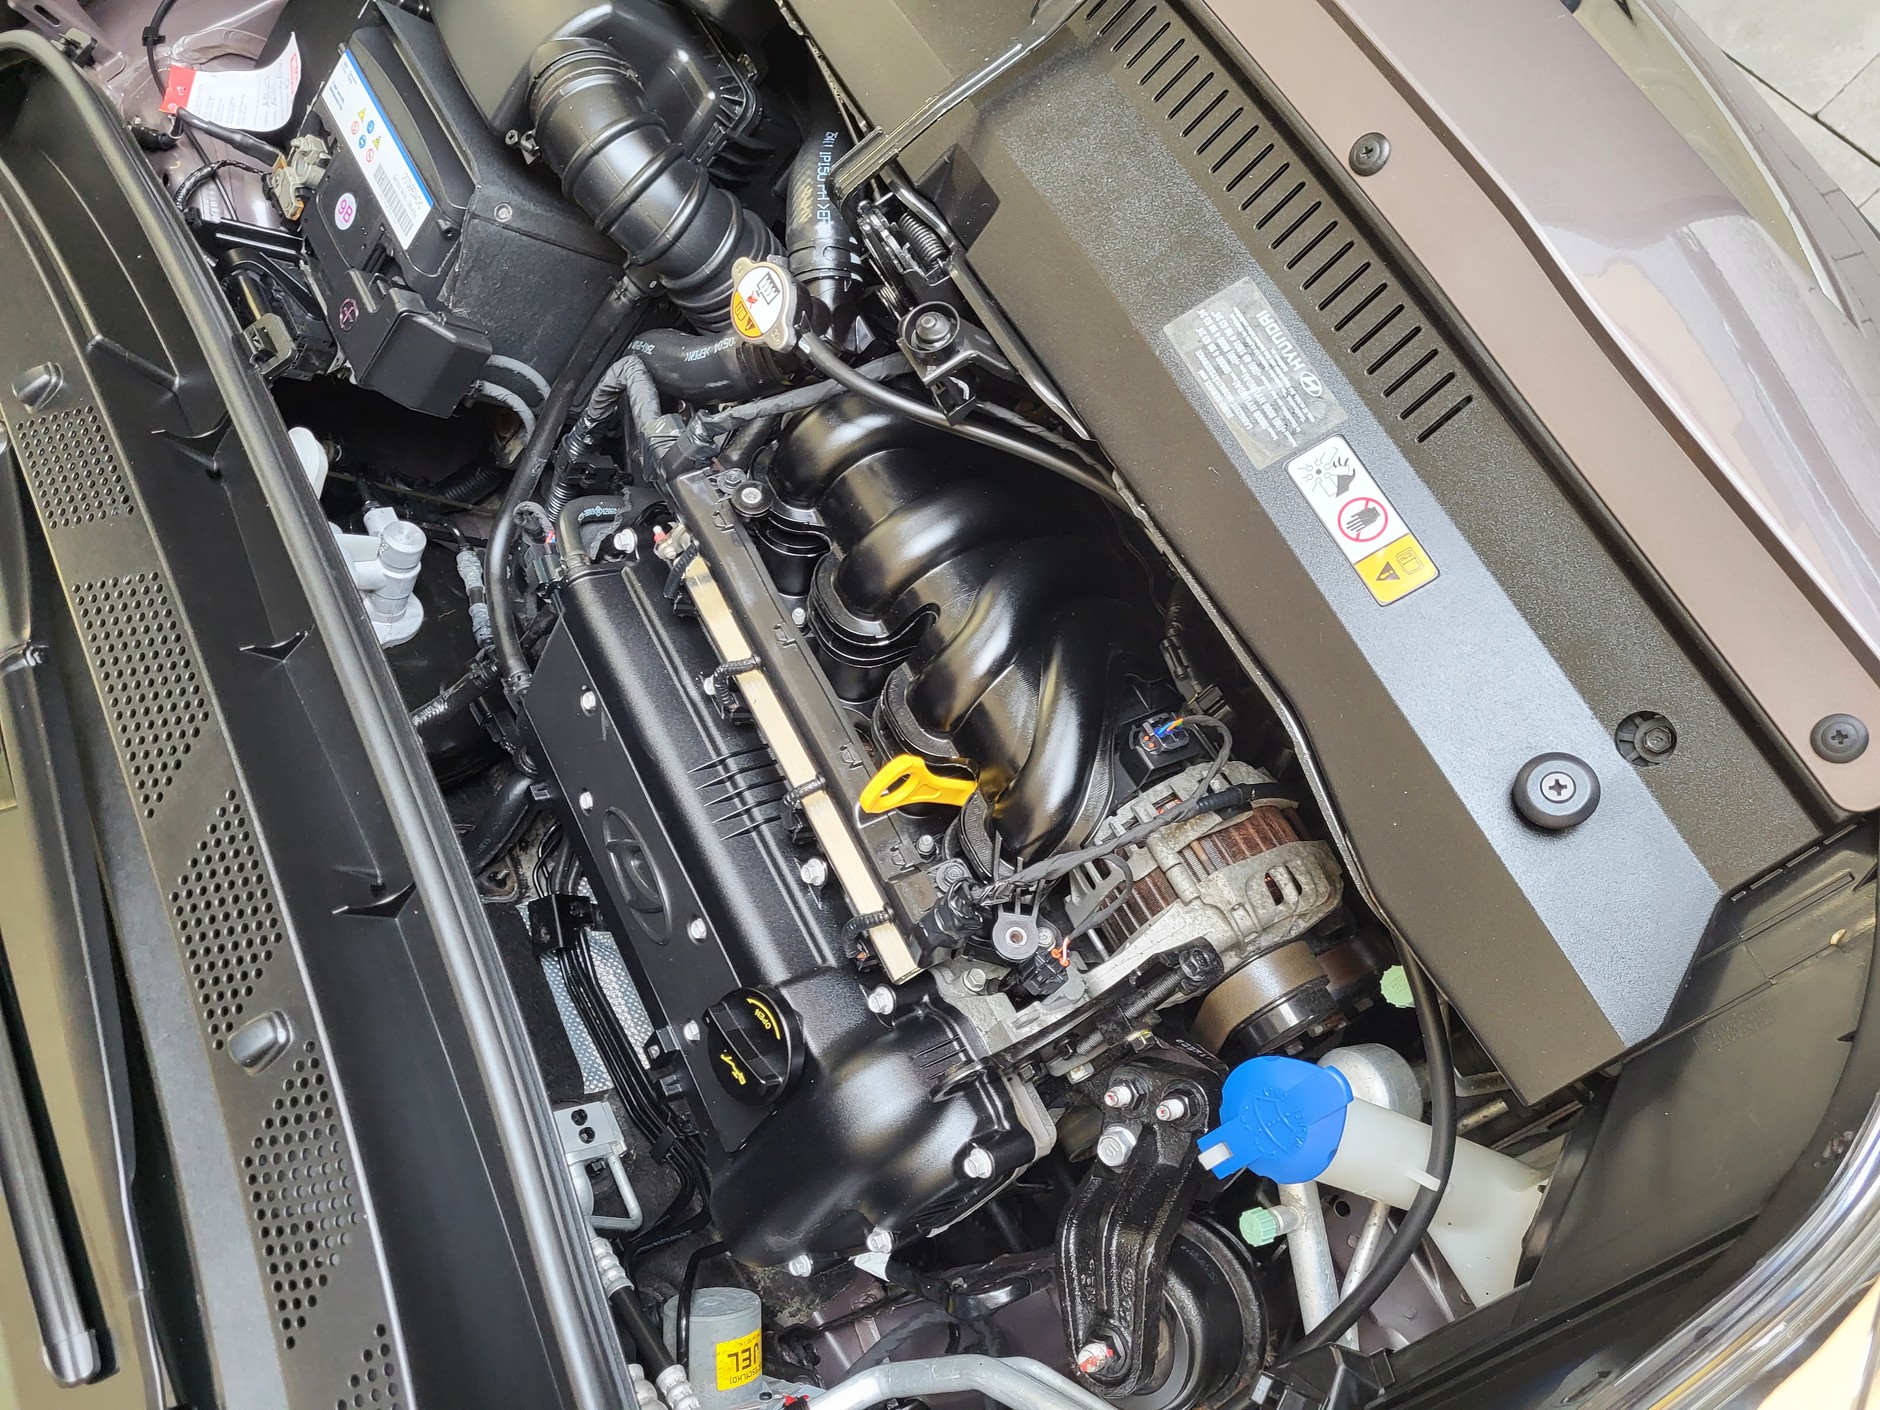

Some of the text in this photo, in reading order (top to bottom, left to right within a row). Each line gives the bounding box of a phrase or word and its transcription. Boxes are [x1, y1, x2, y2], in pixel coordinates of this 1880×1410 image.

[338, 198, 354, 224] 9B
[1255, 308, 1305, 372] HYUNDAI
[1203, 378, 1234, 418] EURO-SERVICE
[1231, 379, 1258, 412] HYUNDAI
[1241, 371, 1267, 404] HYUNDAI
[754, 1008, 772, 1030] OPEN
